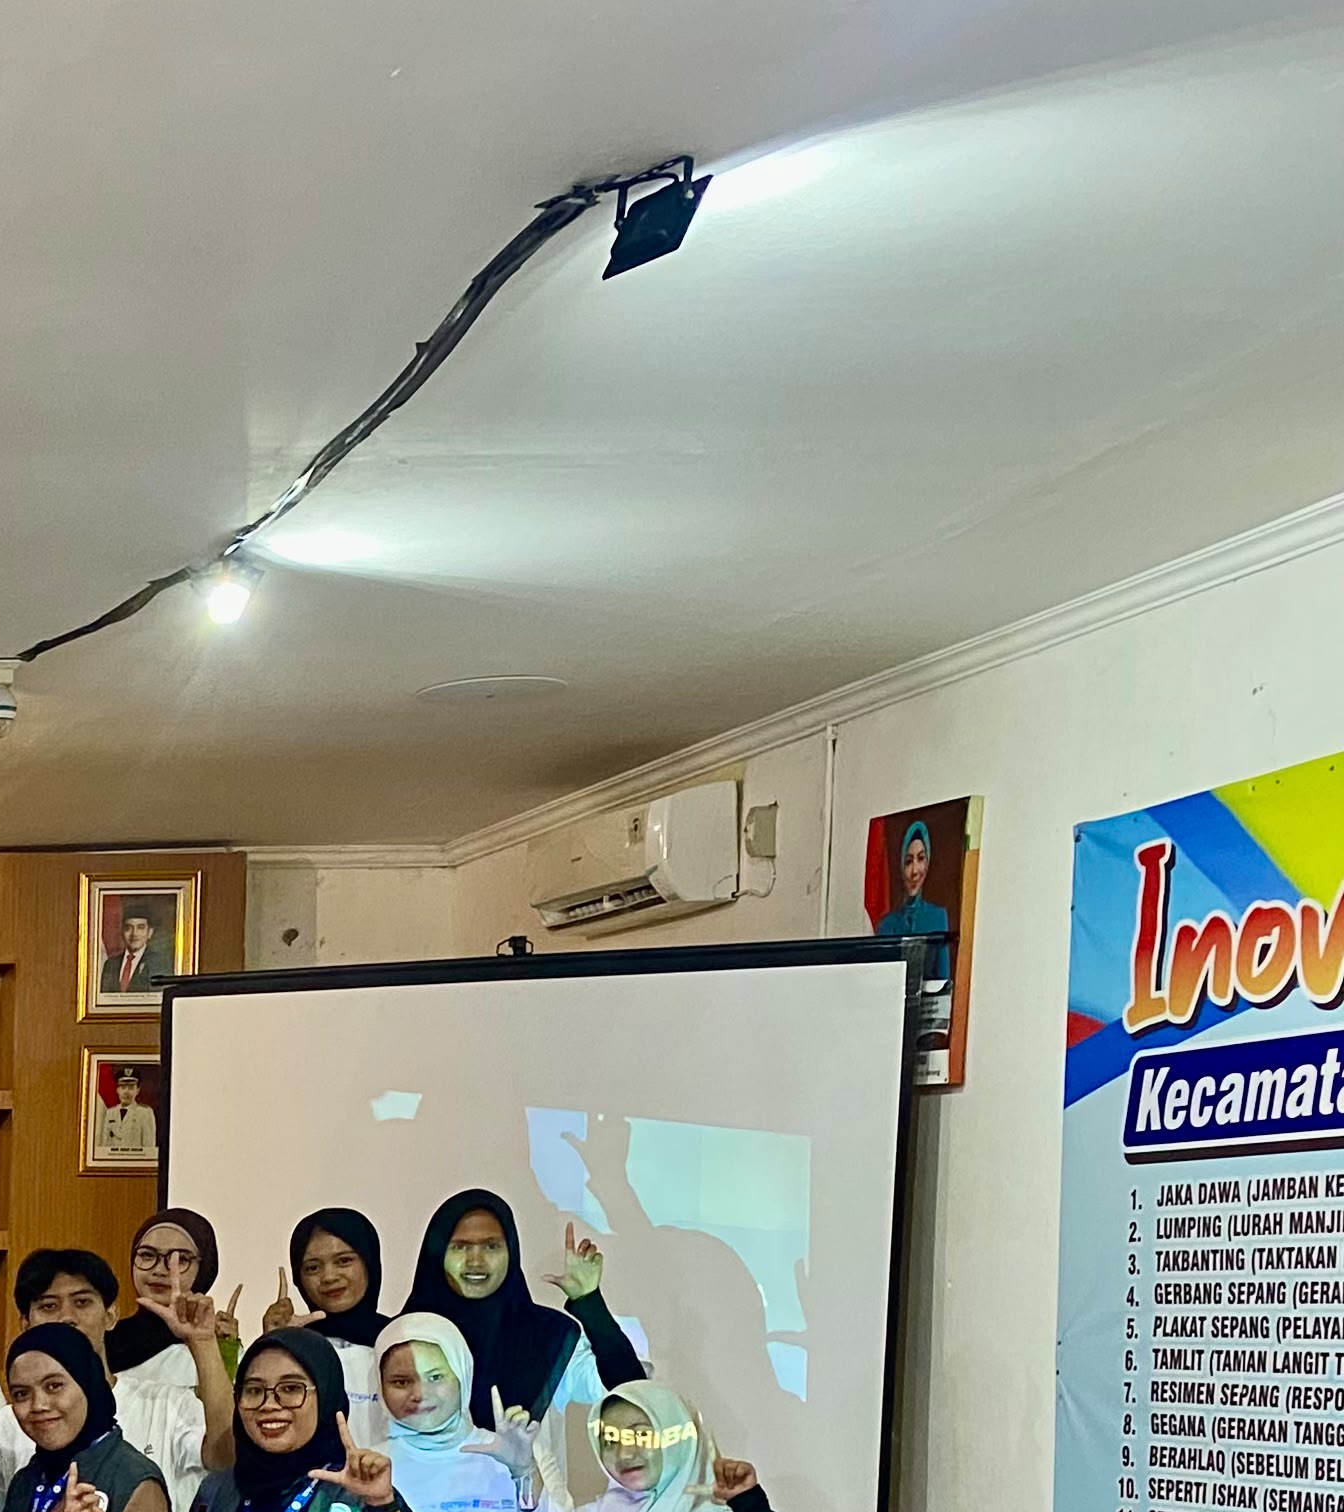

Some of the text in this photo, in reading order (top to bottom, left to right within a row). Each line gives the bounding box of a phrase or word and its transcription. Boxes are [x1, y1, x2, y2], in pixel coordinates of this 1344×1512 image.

[1131, 1190, 1142, 1210] 1.
[1157, 1183, 1193, 1207] JAKA
[1198, 1180, 1241, 1205] DAWA
[1247, 1176, 1319, 1207] (JAMBAN
[1129, 1210, 1344, 1243] 2. LUMPING (LURAH MANJI
[1128, 1246, 1337, 1275] 3. TAKBANTING (TAKTAKAN
[1126, 1281, 1344, 1310] 4. GERBANG SEPANG (GERA
[1126, 1316, 1344, 1344] 5. PLAKAT SEPANG (PELAYA
[1125, 1350, 1137, 1371] 6.
[1152, 1349, 1205, 1371] TAMLIT
[1209, 1350, 1267, 1376] (TAMAN
[1272, 1351, 1330, 1375] LANGIT
[1123, 1381, 1136, 1403] 7.
[1150, 1381, 1214, 1405] RESIMEN
[1220, 1383, 1280, 1408] SEPANG
[1123, 1413, 1136, 1435] 8.
[1150, 1413, 1206, 1438] GEGANA
[1211, 1416, 1288, 1443] (GERAKAN
[1122, 1446, 1135, 1467] 9.
[1149, 1445, 1225, 1474] BERAHLAQ
[1231, 1451, 1309, 1479] (SEBELUM
[1118, 1478, 1138, 1500] 10.
[1148, 1478, 1207, 1504] SEPERTI
[1211, 1483, 1258, 1510] ISHAK
